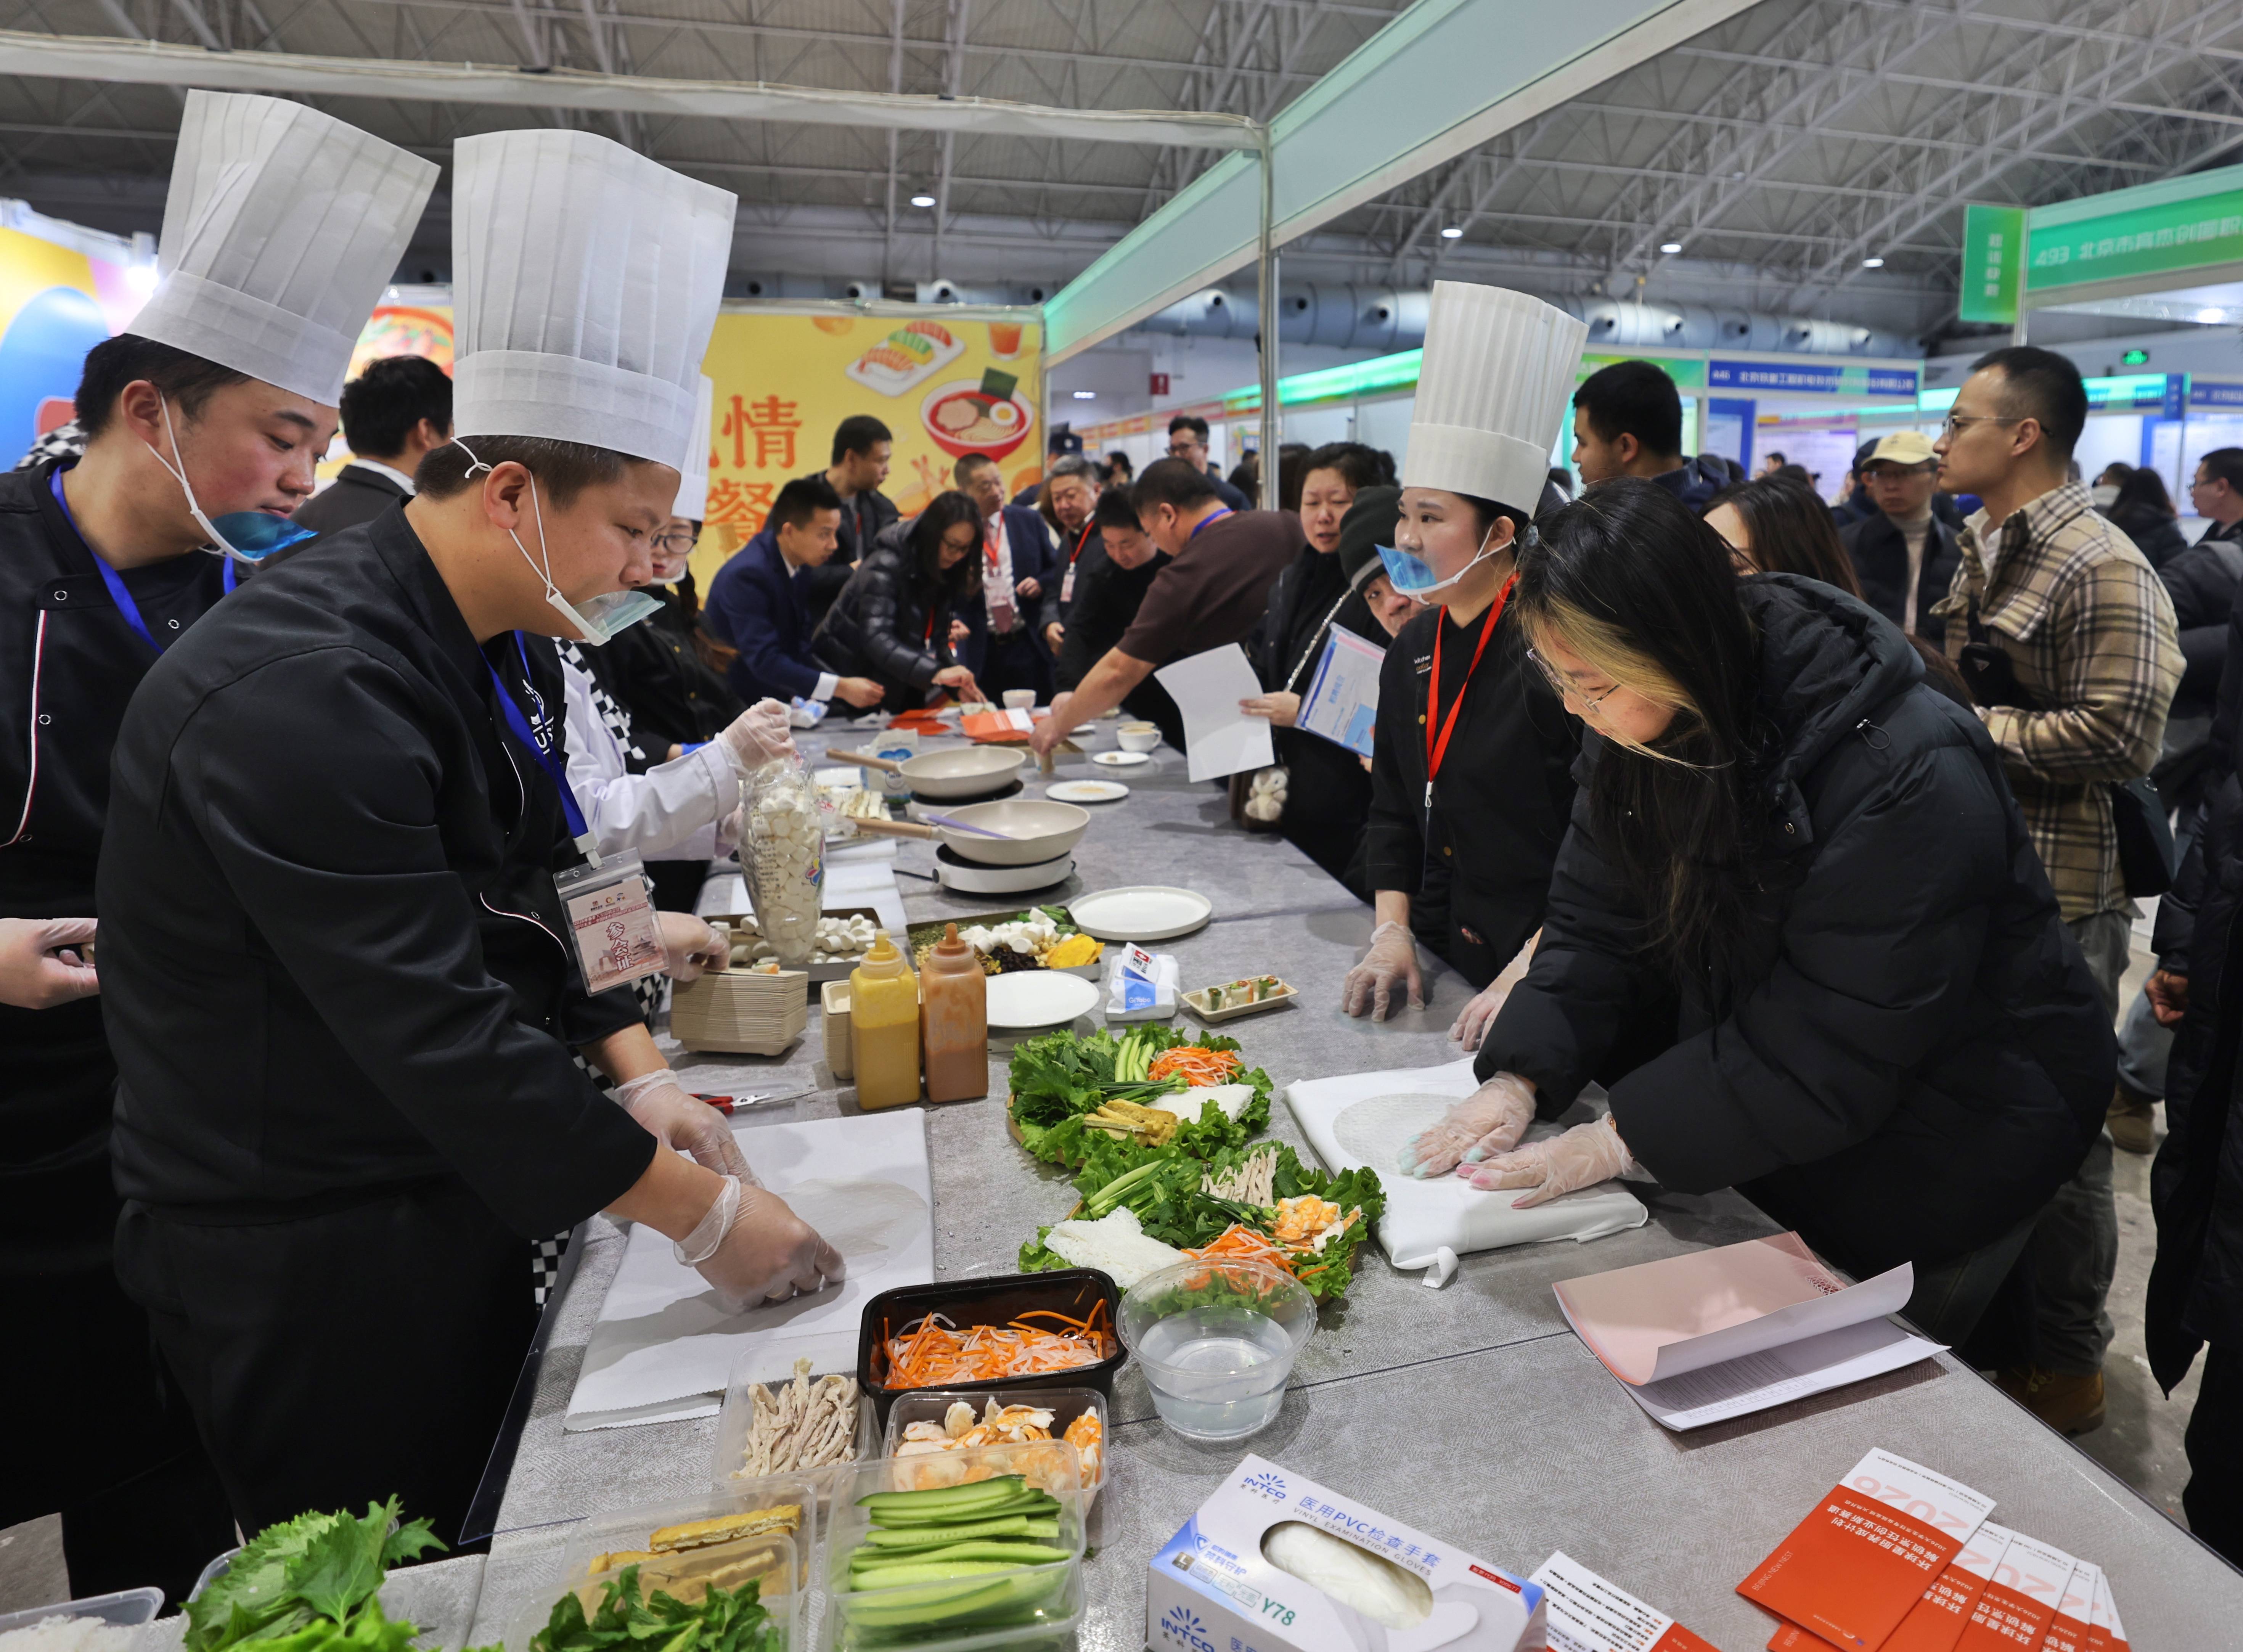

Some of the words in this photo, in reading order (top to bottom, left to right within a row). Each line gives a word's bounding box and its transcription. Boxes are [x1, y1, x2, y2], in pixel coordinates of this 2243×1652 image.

[606, 922, 635, 972] 参会证
[1239, 1484, 1281, 1504] 英科医疗
[1244, 1477, 1286, 1500] INTCO
[1844, 1499, 1869, 1512] 火热开启
[1294, 1507, 1318, 1523] VINYL
[1324, 1521, 1390, 1554] EXAMINATION
[1393, 1553, 1433, 1576] GLOVES
[1299, 1496, 1441, 1568] 医用PVC检查手套
[1826, 1504, 1941, 1563] 解锁烹饪创业新赛道
[1830, 1516, 1933, 1571] 环球星厨养成计划
[1868, 1510, 1947, 1551] 2026大学生烹饪专业就业班
[1179, 1555, 1187, 1565] L
[1204, 1551, 1248, 1575] 英科守护
[1751, 1572, 1772, 1591] BEIJING
[1769, 1560, 1782, 1575] NEW
[1779, 1550, 1794, 1565] NEST
[1939, 1572, 1973, 1592] 2026大学
[1261, 1597, 1296, 1626] Y78
[1922, 1589, 1963, 1615] 环球星
[1977, 1602, 2037, 1636] 解锁烹饪
[1162, 1617, 1215, 1652] INTCO
[1971, 1610, 2032, 1646] 环球星厨
